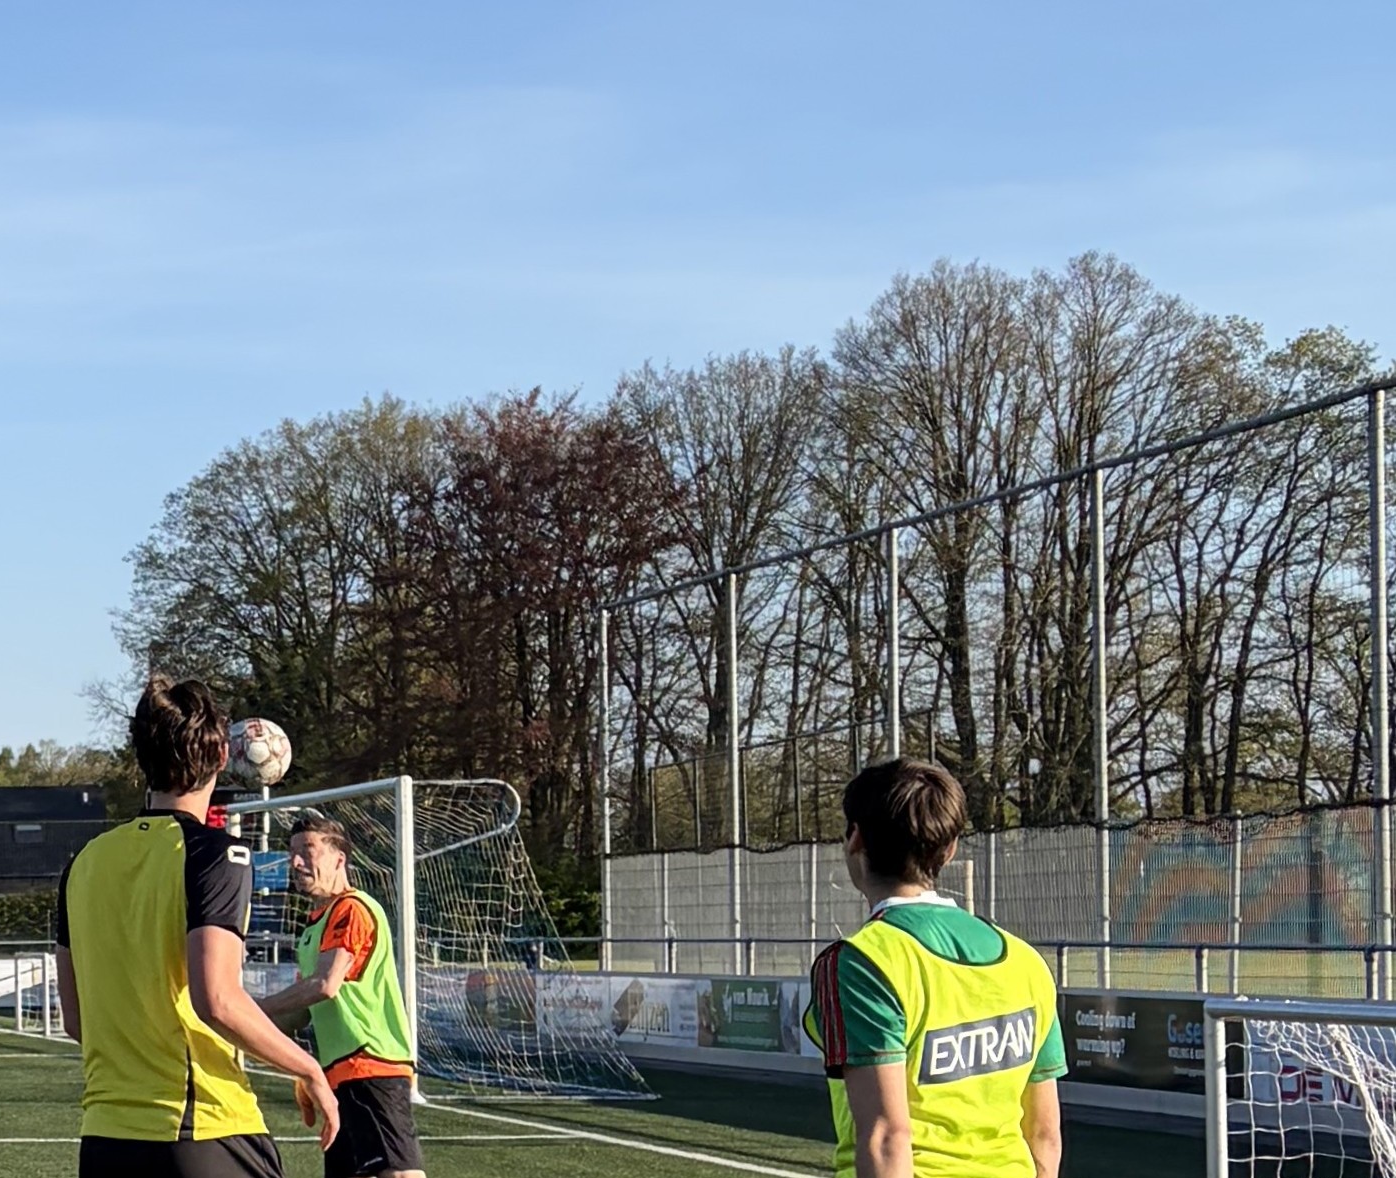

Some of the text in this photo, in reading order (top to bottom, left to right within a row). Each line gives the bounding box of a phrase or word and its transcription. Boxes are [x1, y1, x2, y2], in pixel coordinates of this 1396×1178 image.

[1075, 1009, 1104, 1032] Cooling
[1105, 1009, 1126, 1029] down
[929, 1015, 1034, 1076] EXTRAN
[1075, 1035, 1110, 1058] warming
